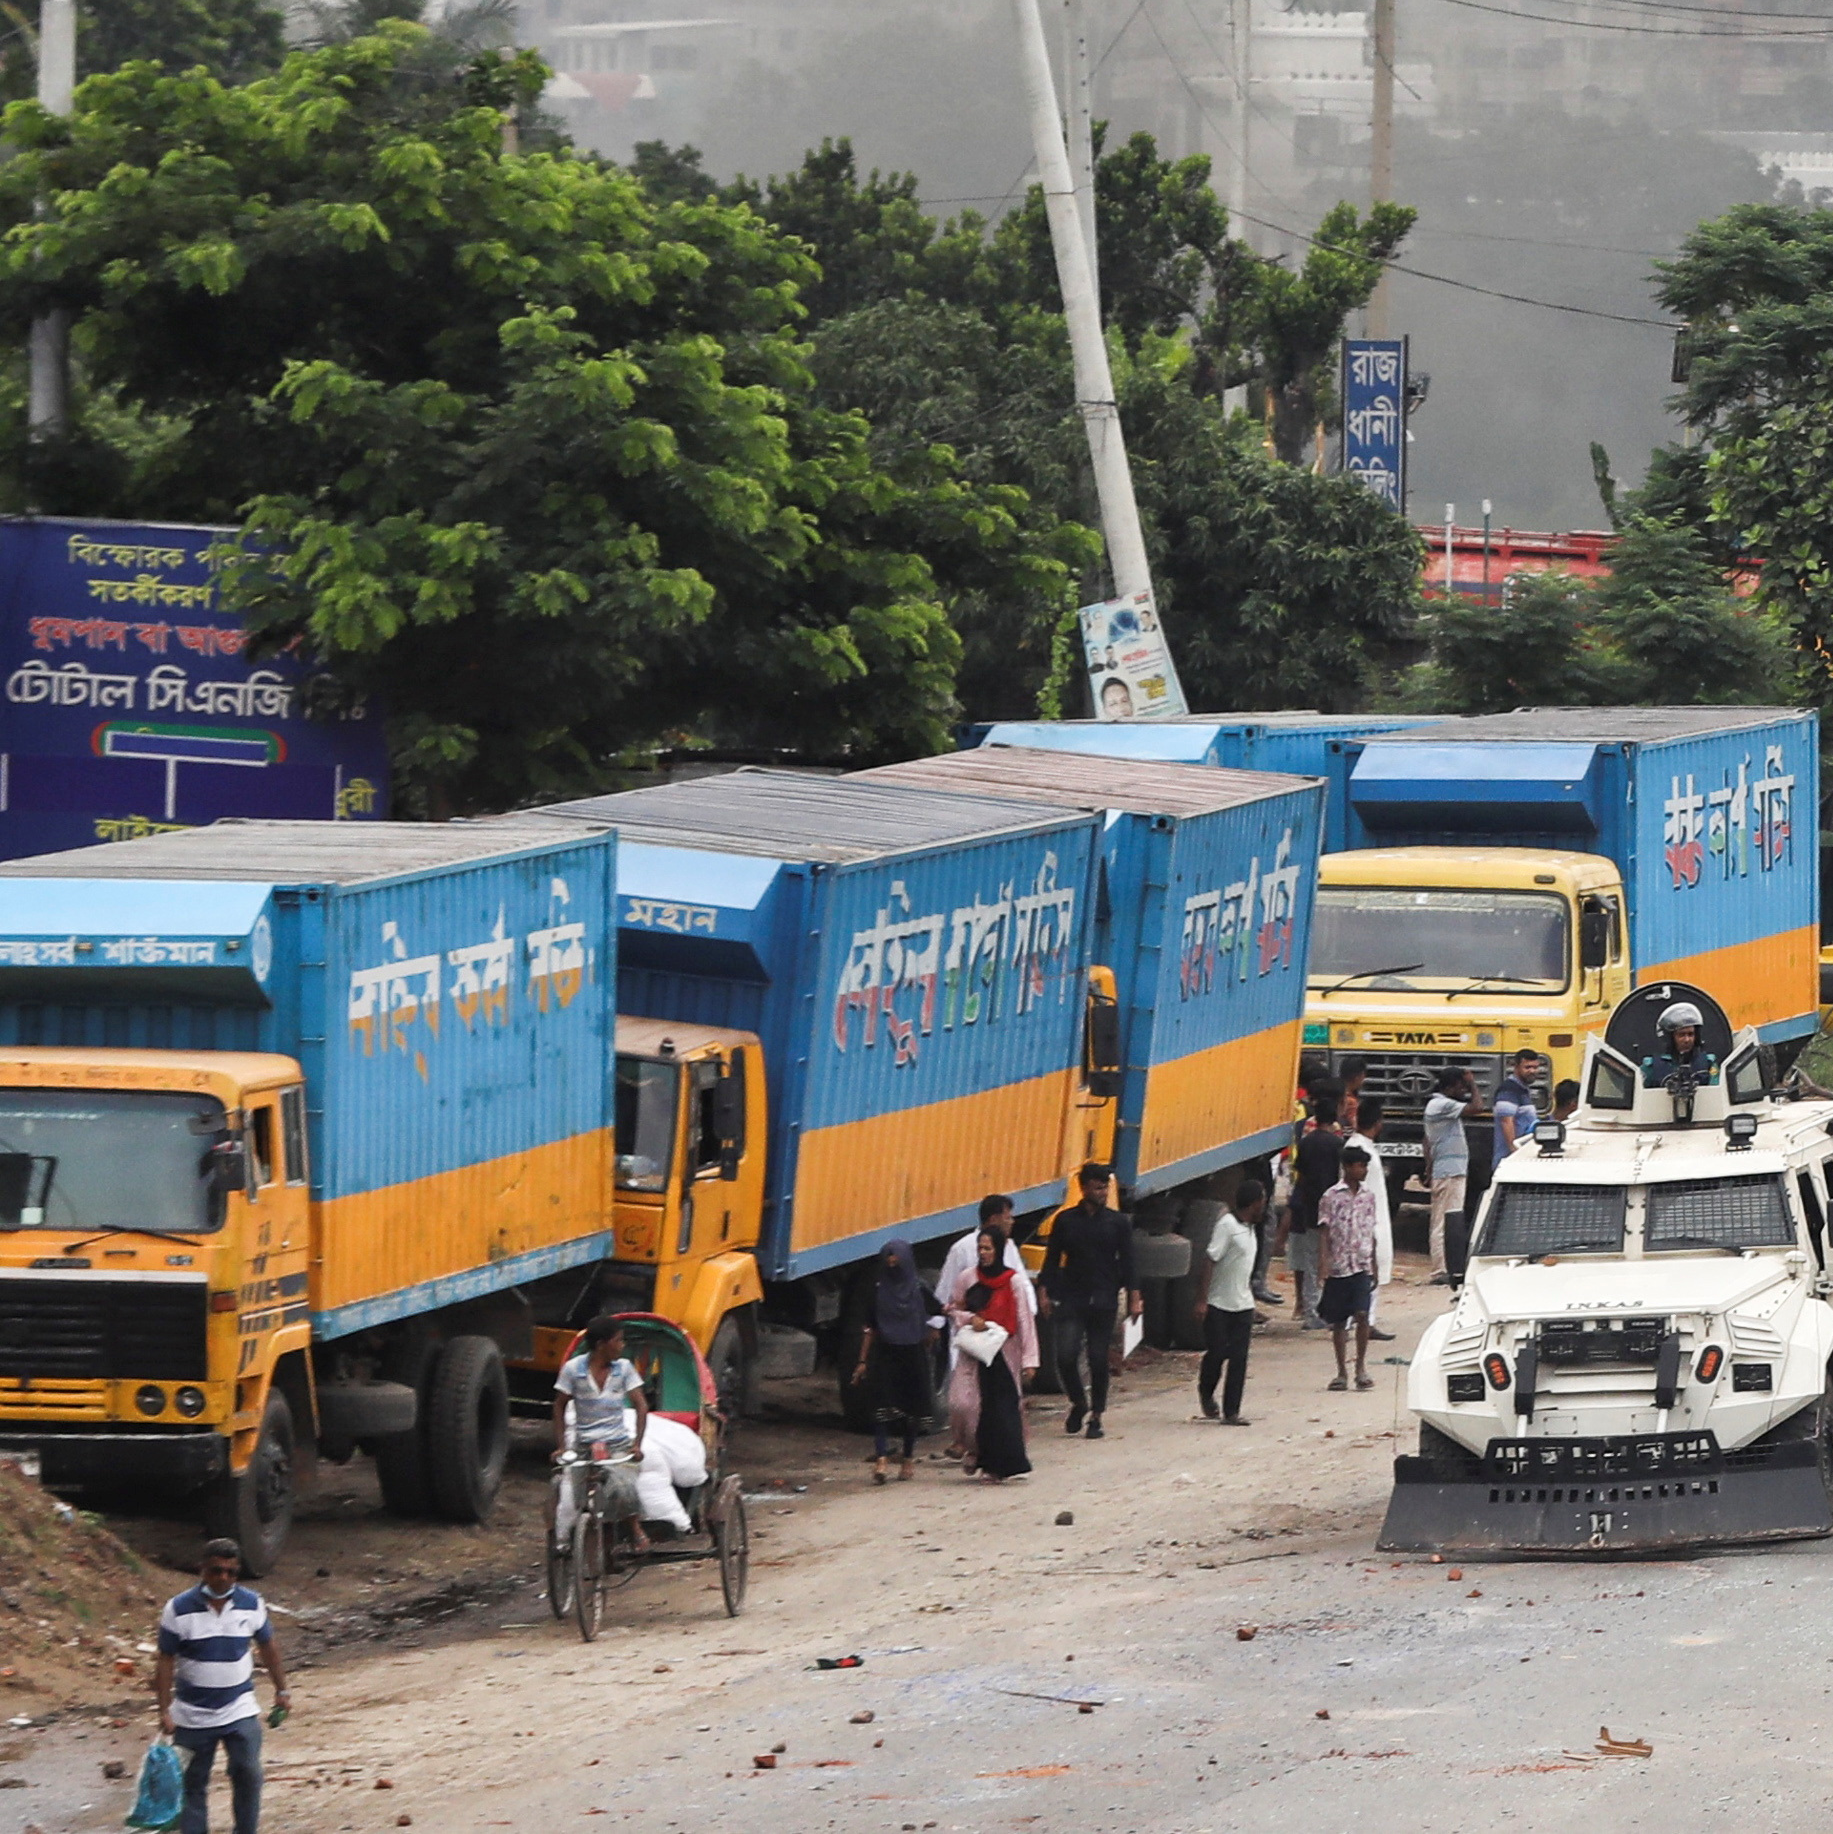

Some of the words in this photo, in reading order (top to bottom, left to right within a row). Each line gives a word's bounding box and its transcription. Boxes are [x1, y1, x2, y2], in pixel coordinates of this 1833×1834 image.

[1350, 345, 1398, 387] রাজ
[1349, 395, 1398, 446] ধানী
[6, 659, 139, 710] টোটাল
[145, 664, 295, 719] সিএনজি
[626, 898, 718, 934] মহান
[1395, 1032, 1436, 1044] TATA
[1566, 1300, 1643, 1310] INKAS
